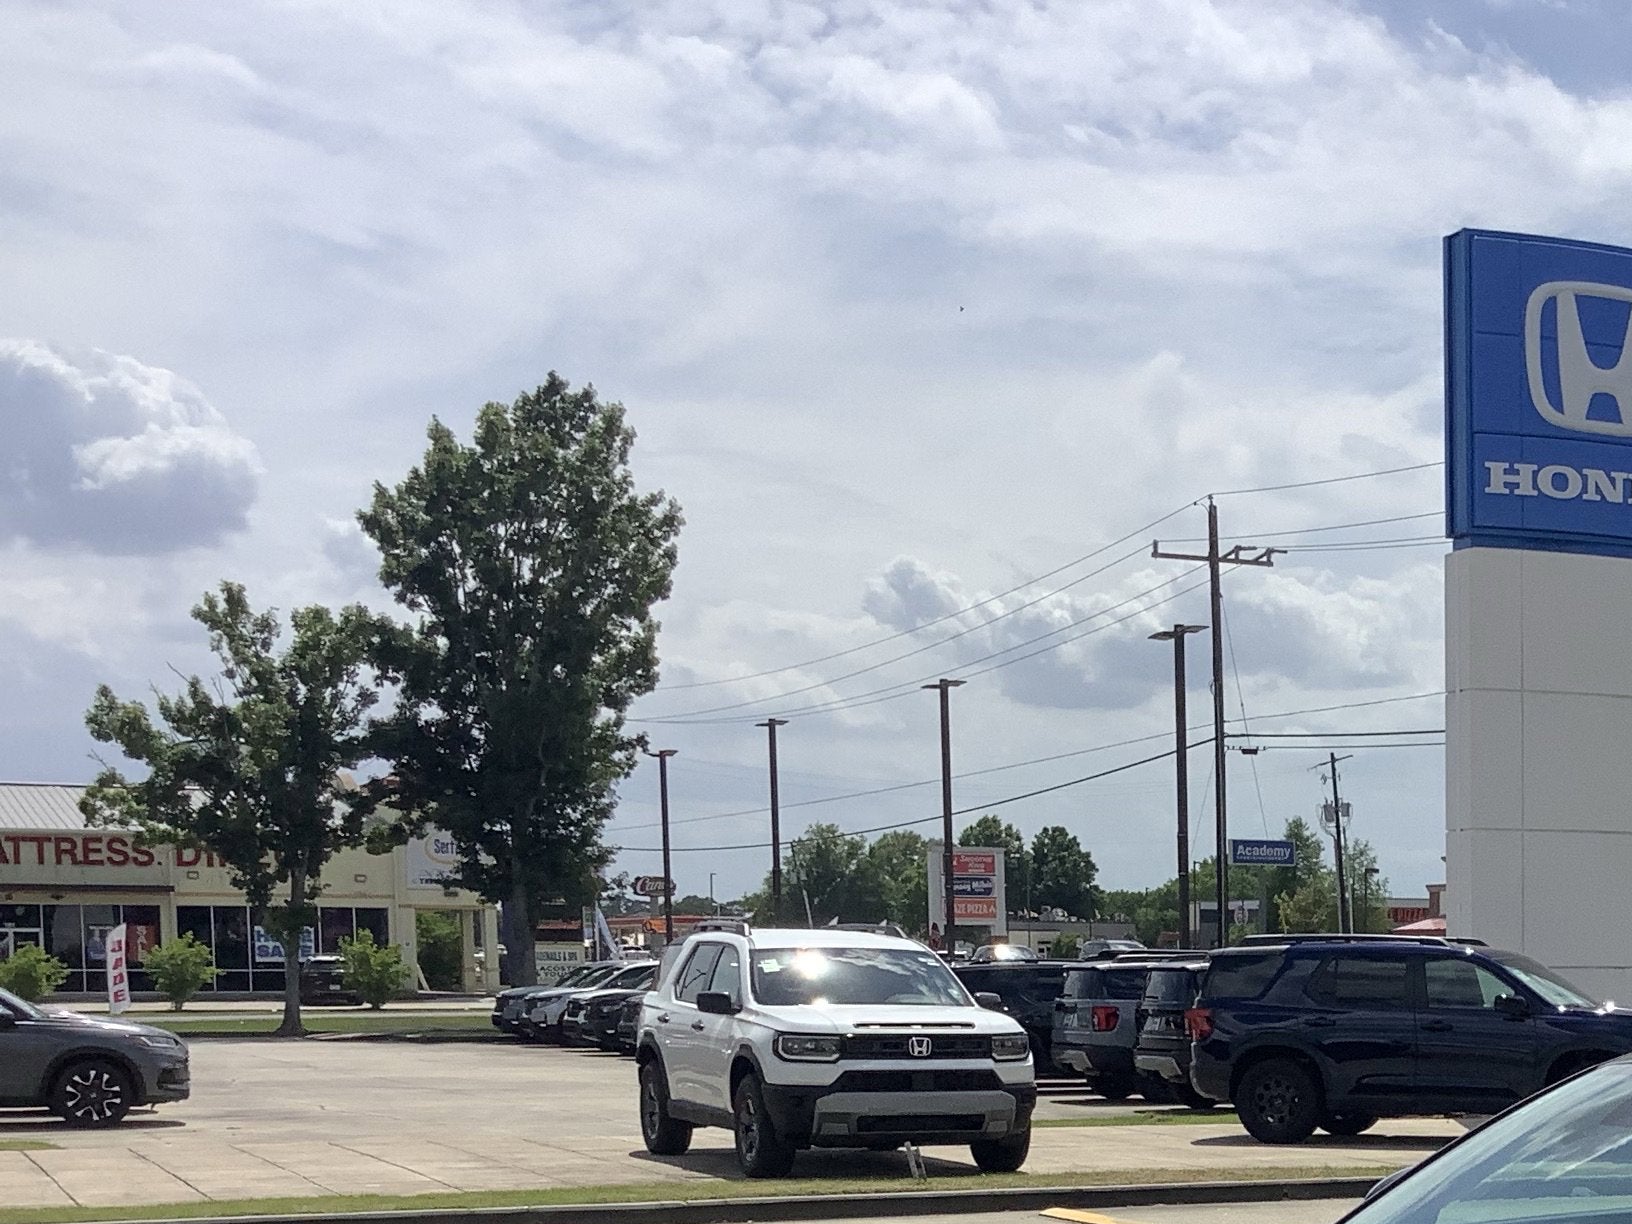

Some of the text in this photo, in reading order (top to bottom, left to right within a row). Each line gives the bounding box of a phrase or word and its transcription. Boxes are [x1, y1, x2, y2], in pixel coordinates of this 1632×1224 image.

[434, 839, 457, 855] Sert
[1237, 844, 1291, 860] Academy
[256, 944, 312, 958] SAE
